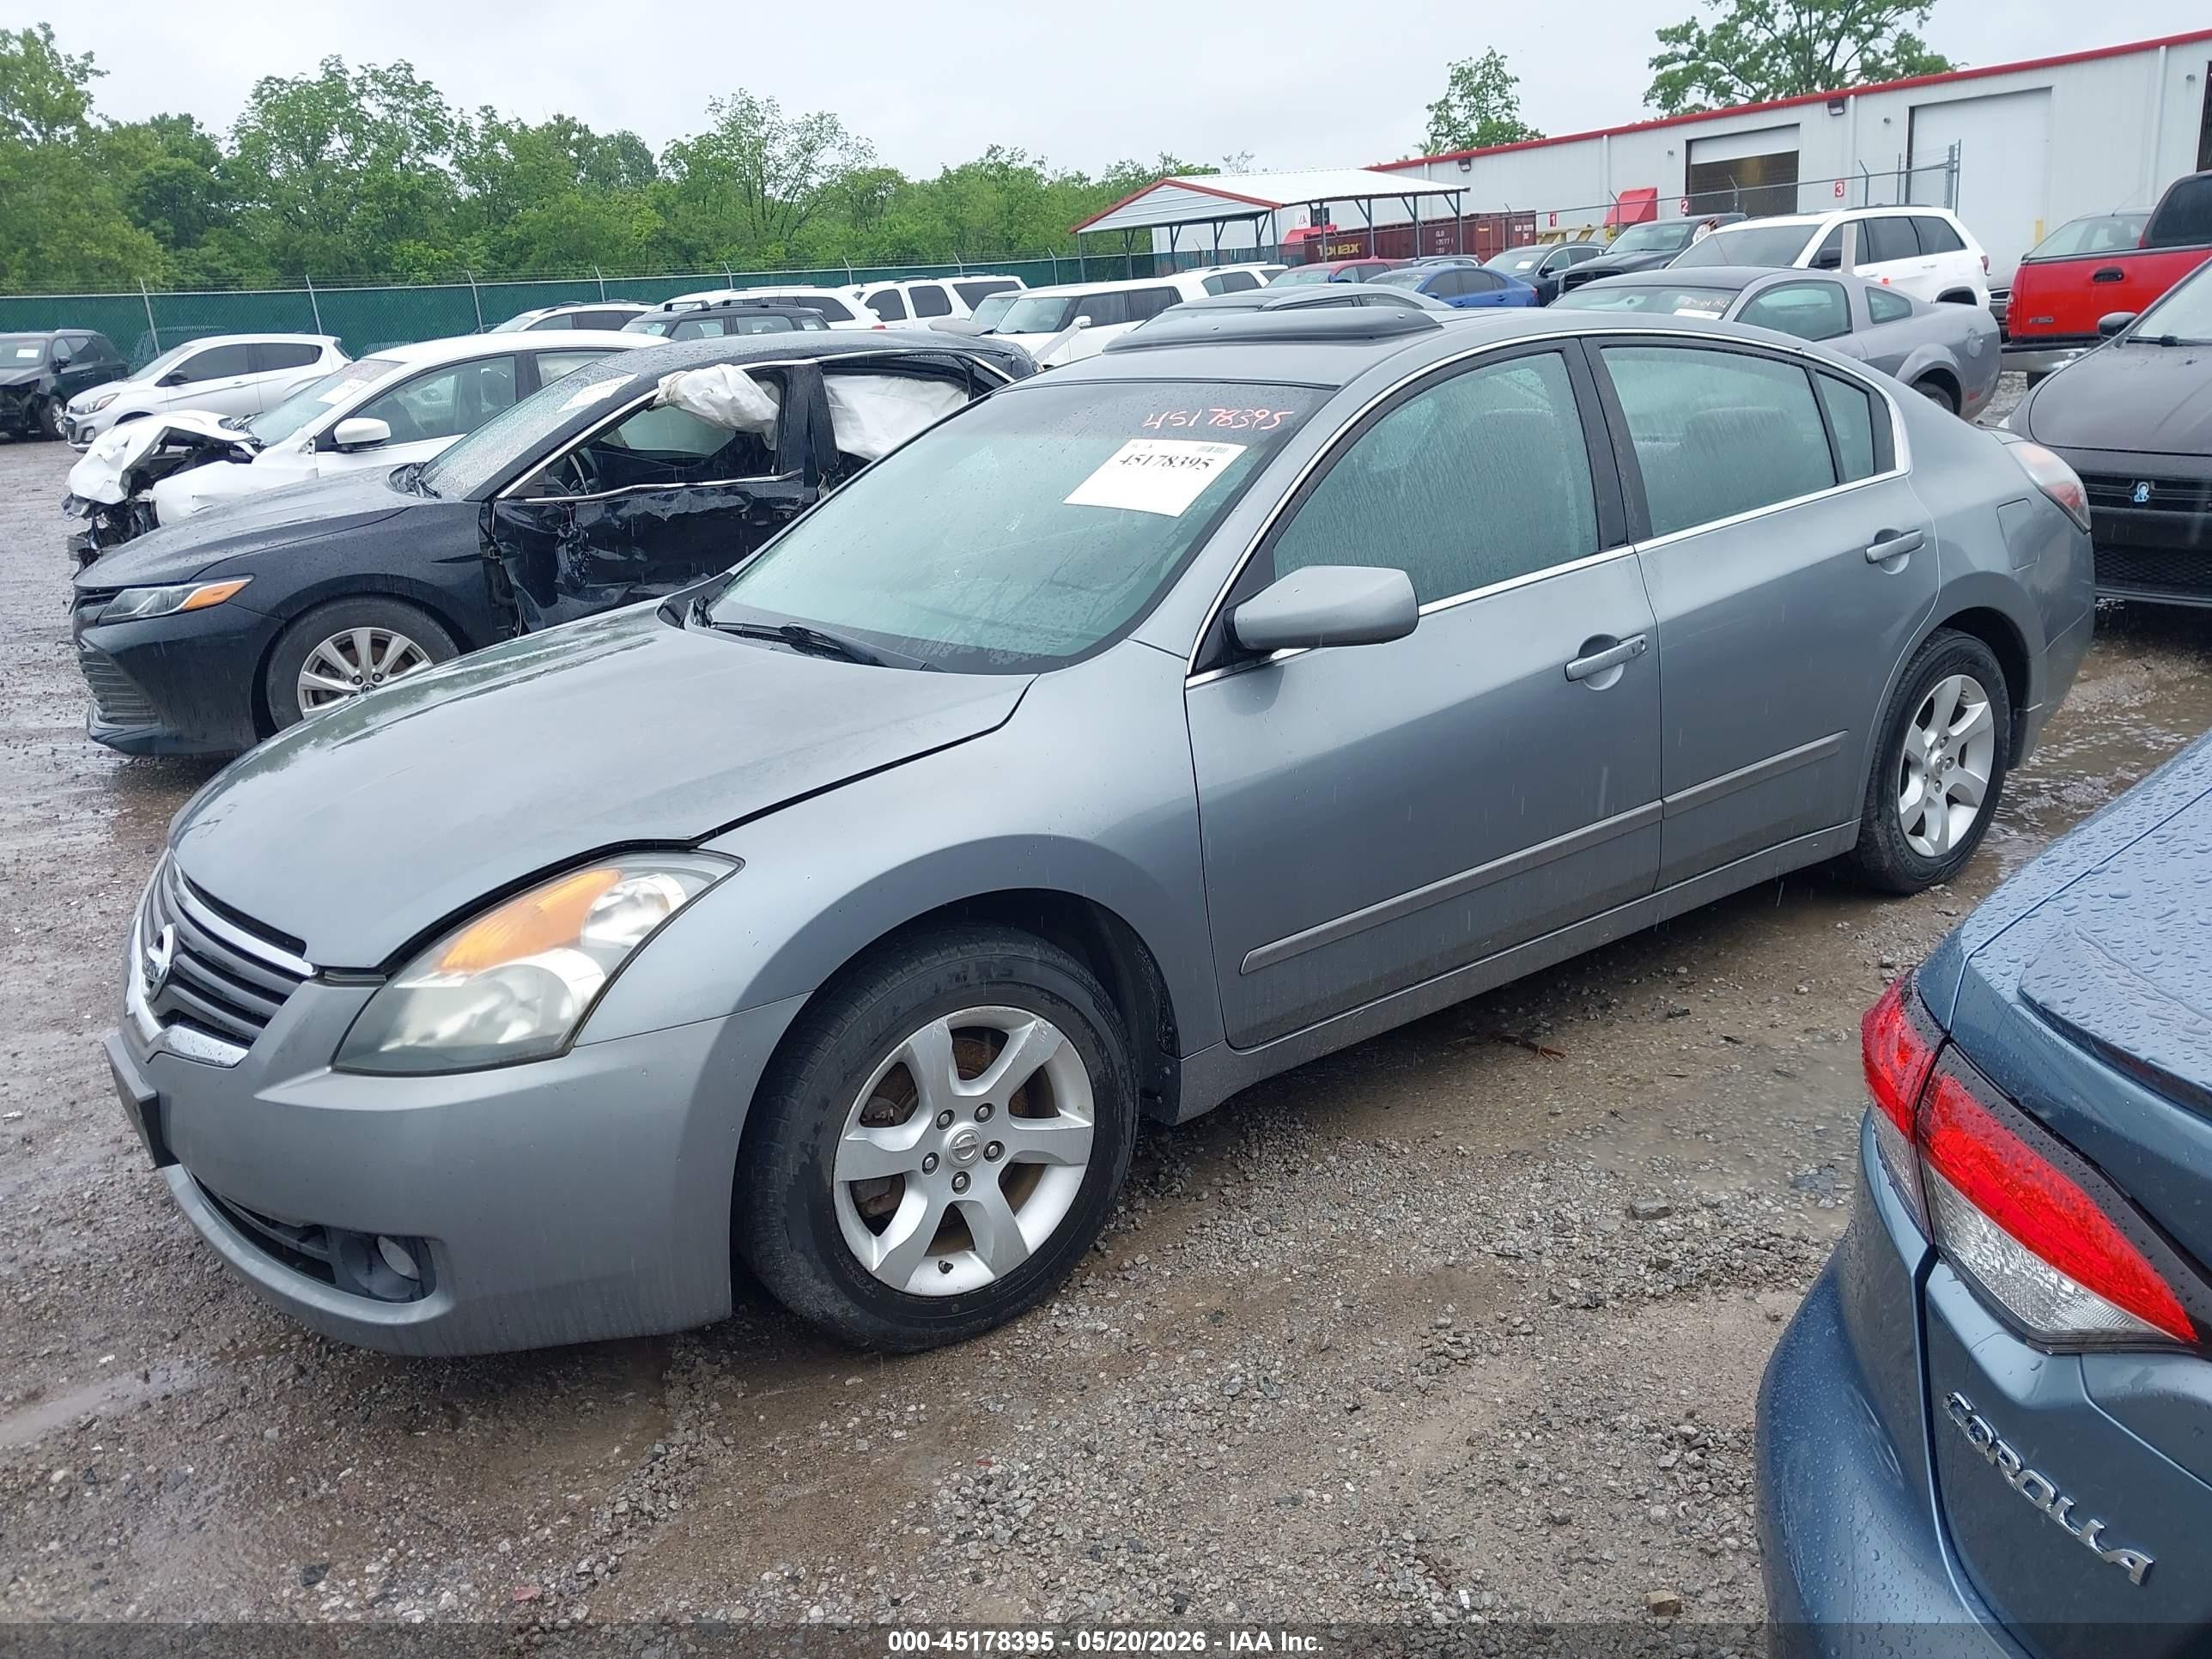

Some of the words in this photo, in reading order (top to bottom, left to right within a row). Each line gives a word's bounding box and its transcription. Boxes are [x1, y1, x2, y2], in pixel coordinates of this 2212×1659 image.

[1142, 409, 1295, 429] 45178395
[1120, 453, 1214, 470] 45178395
[1942, 1391, 2155, 1586] COROLLA
